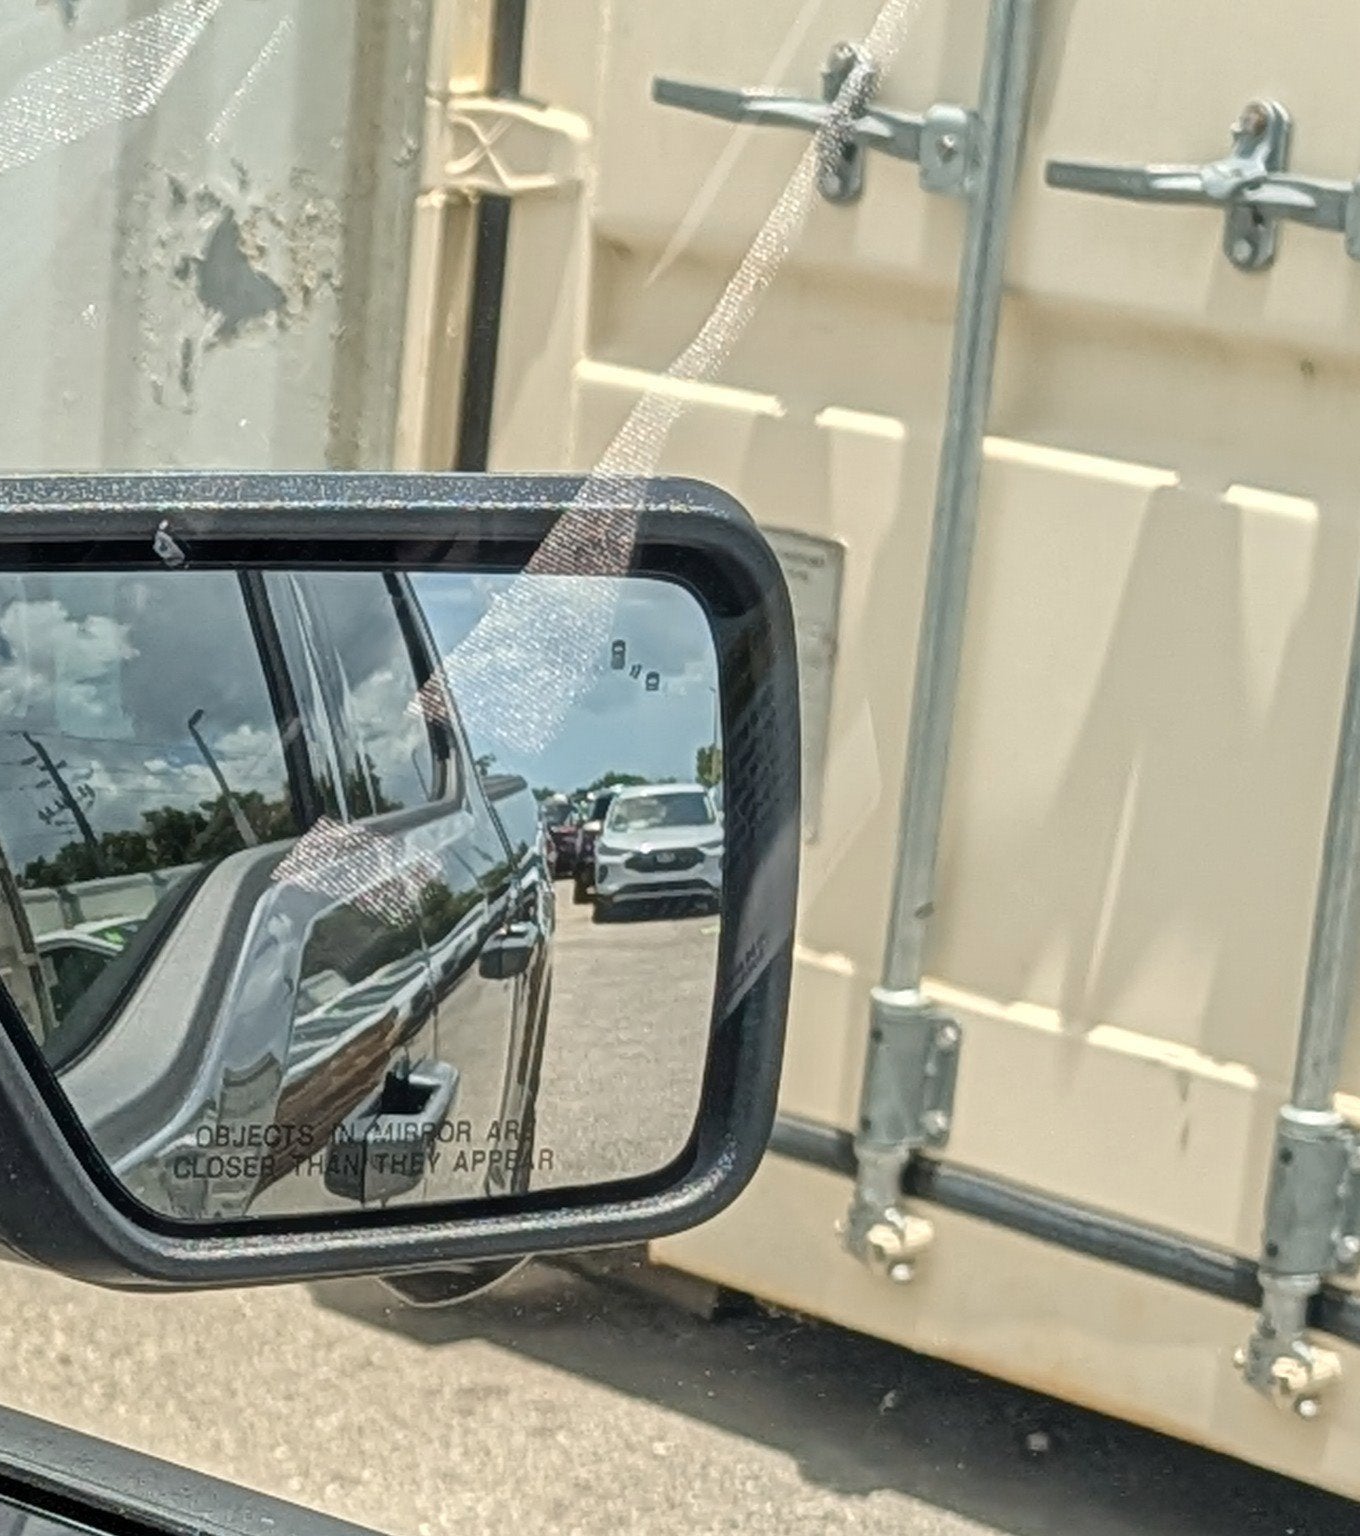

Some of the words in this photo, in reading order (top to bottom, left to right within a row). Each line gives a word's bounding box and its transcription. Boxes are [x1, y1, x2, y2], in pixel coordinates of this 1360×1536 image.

[195, 1122, 314, 1150] OBJECTS
[331, 1122, 357, 1145] IN
[366, 1120, 472, 1146] MIRROR
[173, 1154, 276, 1181] CLOSER
[292, 1151, 361, 1178] THAN
[376, 1150, 441, 1176] THEY
[452, 1147, 555, 1173] APPEAR
